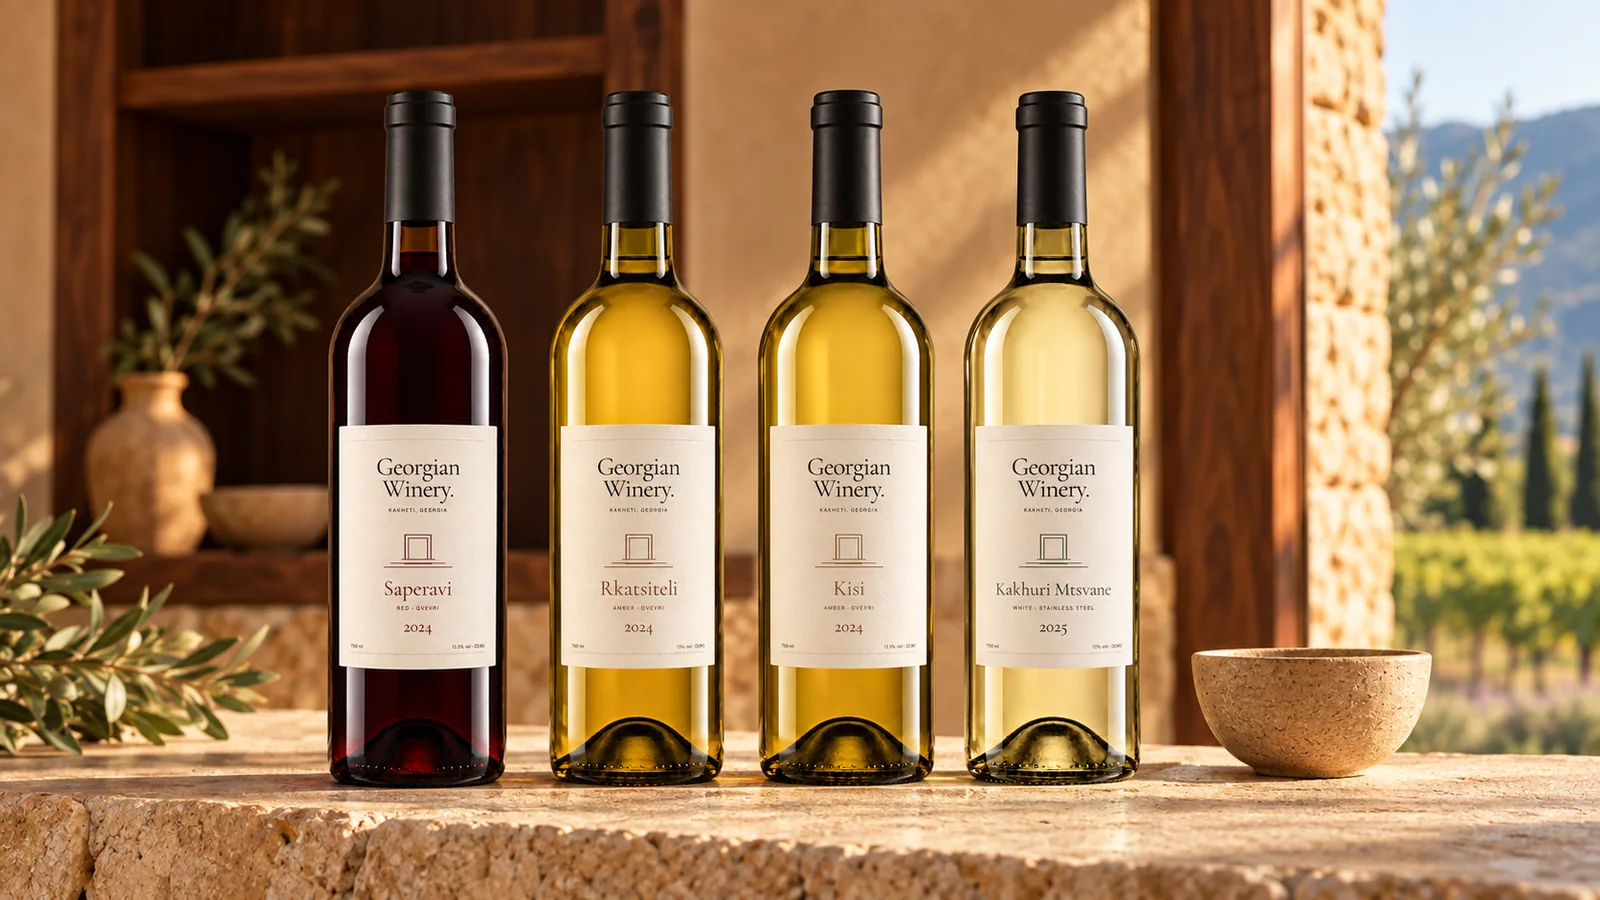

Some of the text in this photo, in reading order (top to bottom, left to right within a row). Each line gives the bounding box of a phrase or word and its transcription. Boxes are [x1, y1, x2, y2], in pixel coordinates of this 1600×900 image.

[377, 457, 460, 482] Georgian
[598, 457, 680, 482] Georgian
[808, 457, 890, 482] Georgian
[1012, 457, 1095, 482] Georgian
[383, 479, 454, 504] Winery.
[604, 479, 675, 504] Winery.
[813, 479, 884, 504] Winery.
[1017, 479, 1089, 504] Winery.
[384, 580, 452, 602] Saperavi
[601, 579, 678, 597] Rkatsiteli
[834, 580, 865, 597] Kisi
[996, 581, 1112, 597] Kakhuri Mtsvane
[403, 623, 433, 636] 2024
[624, 623, 654, 636] 2024
[835, 623, 864, 636] 2024
[1039, 623, 1068, 636] 2025
